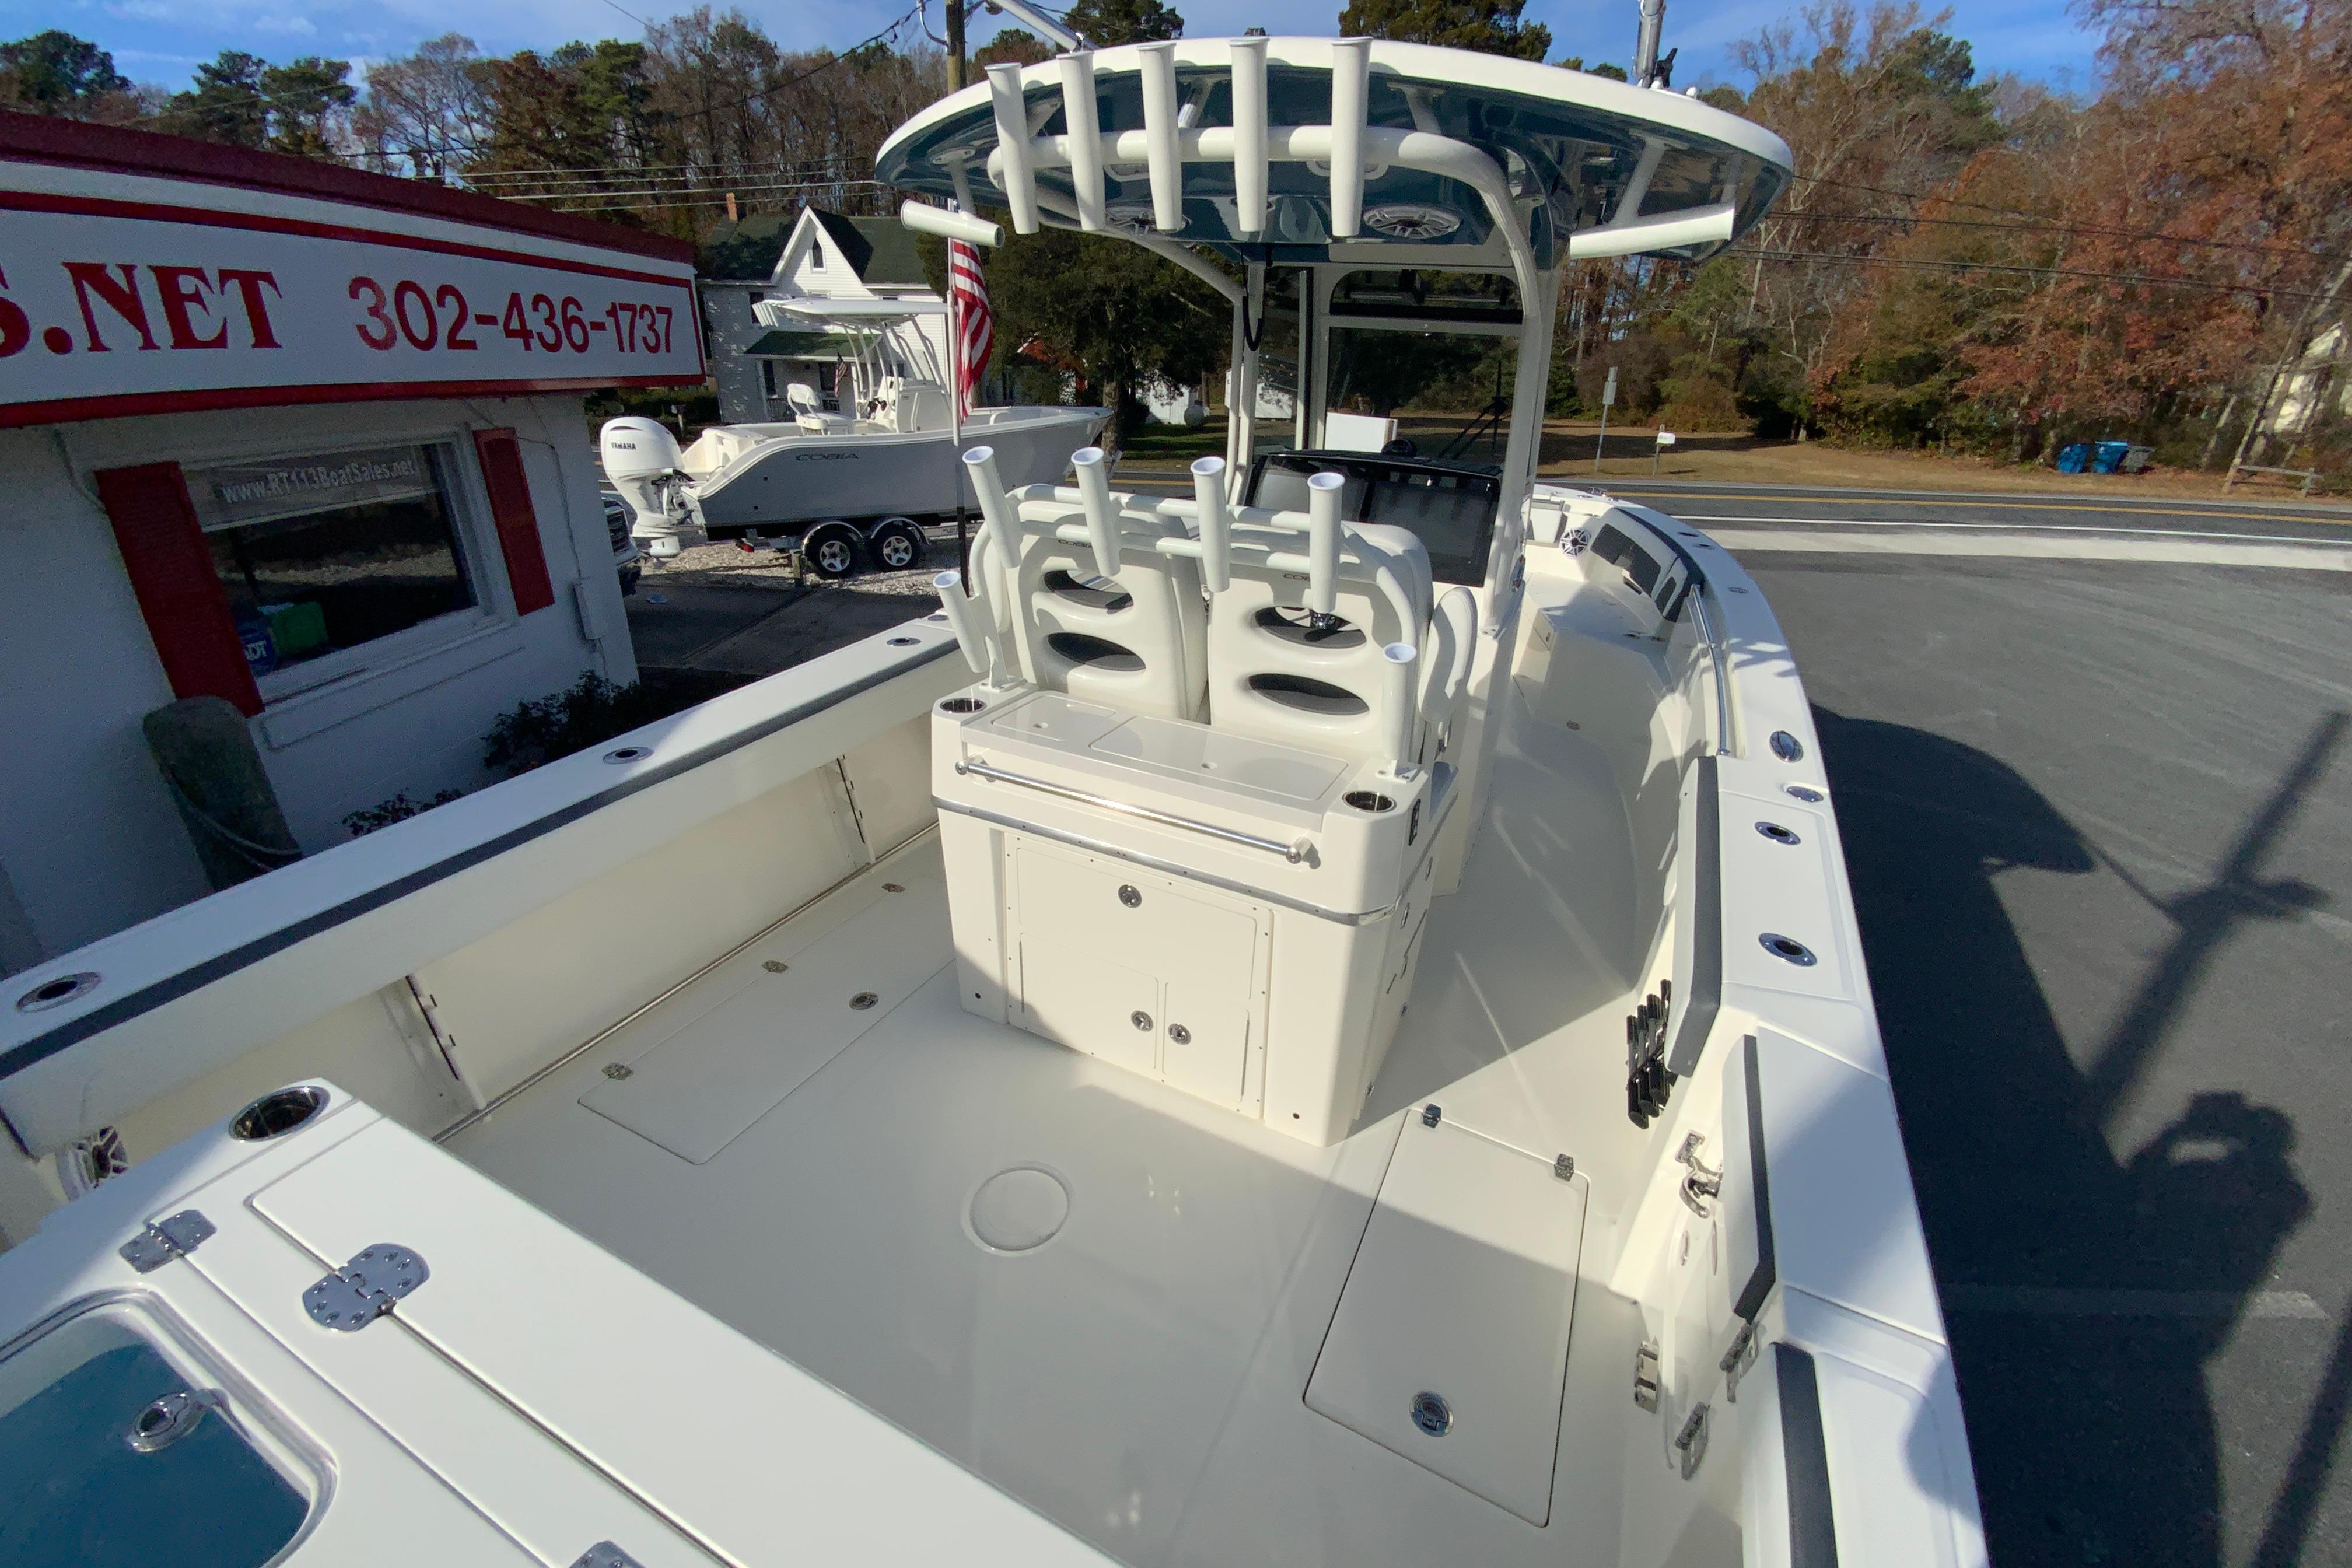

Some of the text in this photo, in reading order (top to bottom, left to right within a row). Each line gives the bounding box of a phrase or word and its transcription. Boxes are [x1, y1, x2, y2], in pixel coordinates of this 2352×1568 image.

[349, 276, 673, 354] 302-436-1737
[611, 442, 636, 450] YAMAHA
[221, 459, 416, 503] www.RT113BoatSales.net
